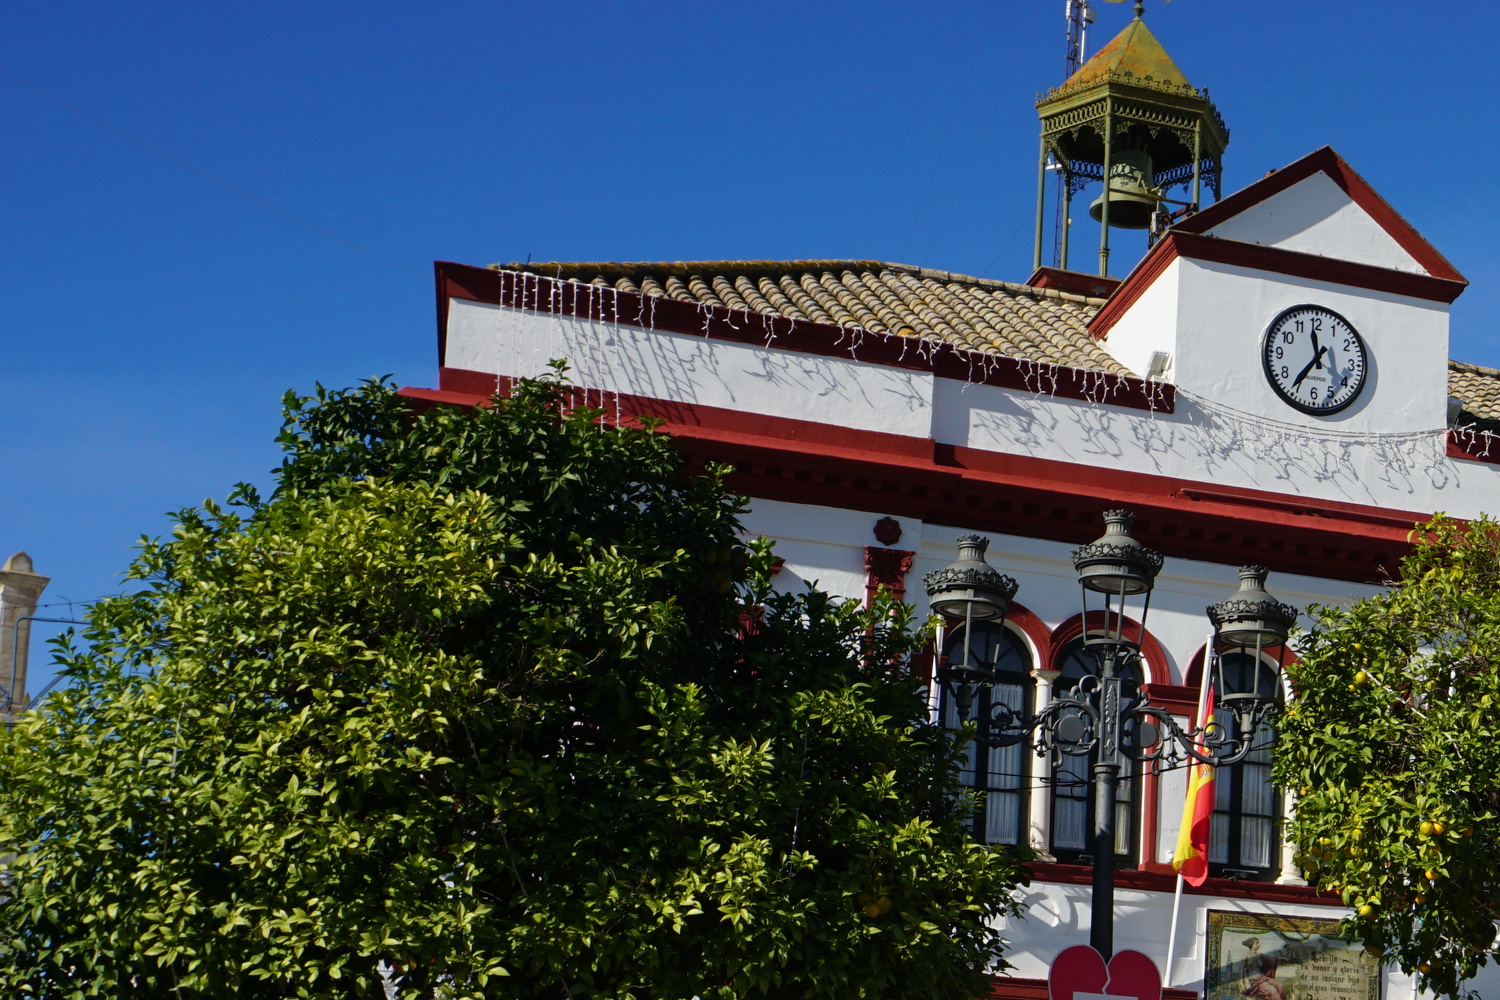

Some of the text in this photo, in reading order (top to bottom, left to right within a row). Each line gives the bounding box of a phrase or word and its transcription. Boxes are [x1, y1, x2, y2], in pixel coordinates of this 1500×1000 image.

[1294, 320, 1304, 333] 11
[1310, 317, 1323, 331] 12
[1281, 331, 1295, 344] 10
[1330, 325, 1336, 337] 1
[1343, 339, 1351, 352] 2
[1275, 346, 1284, 359] 9
[1347, 359, 1355, 371] 3
[1281, 366, 1289, 379] 8
[1340, 376, 1348, 388] 4
[1310, 387, 1318, 400] 6
[1326, 386, 1334, 398] 5
